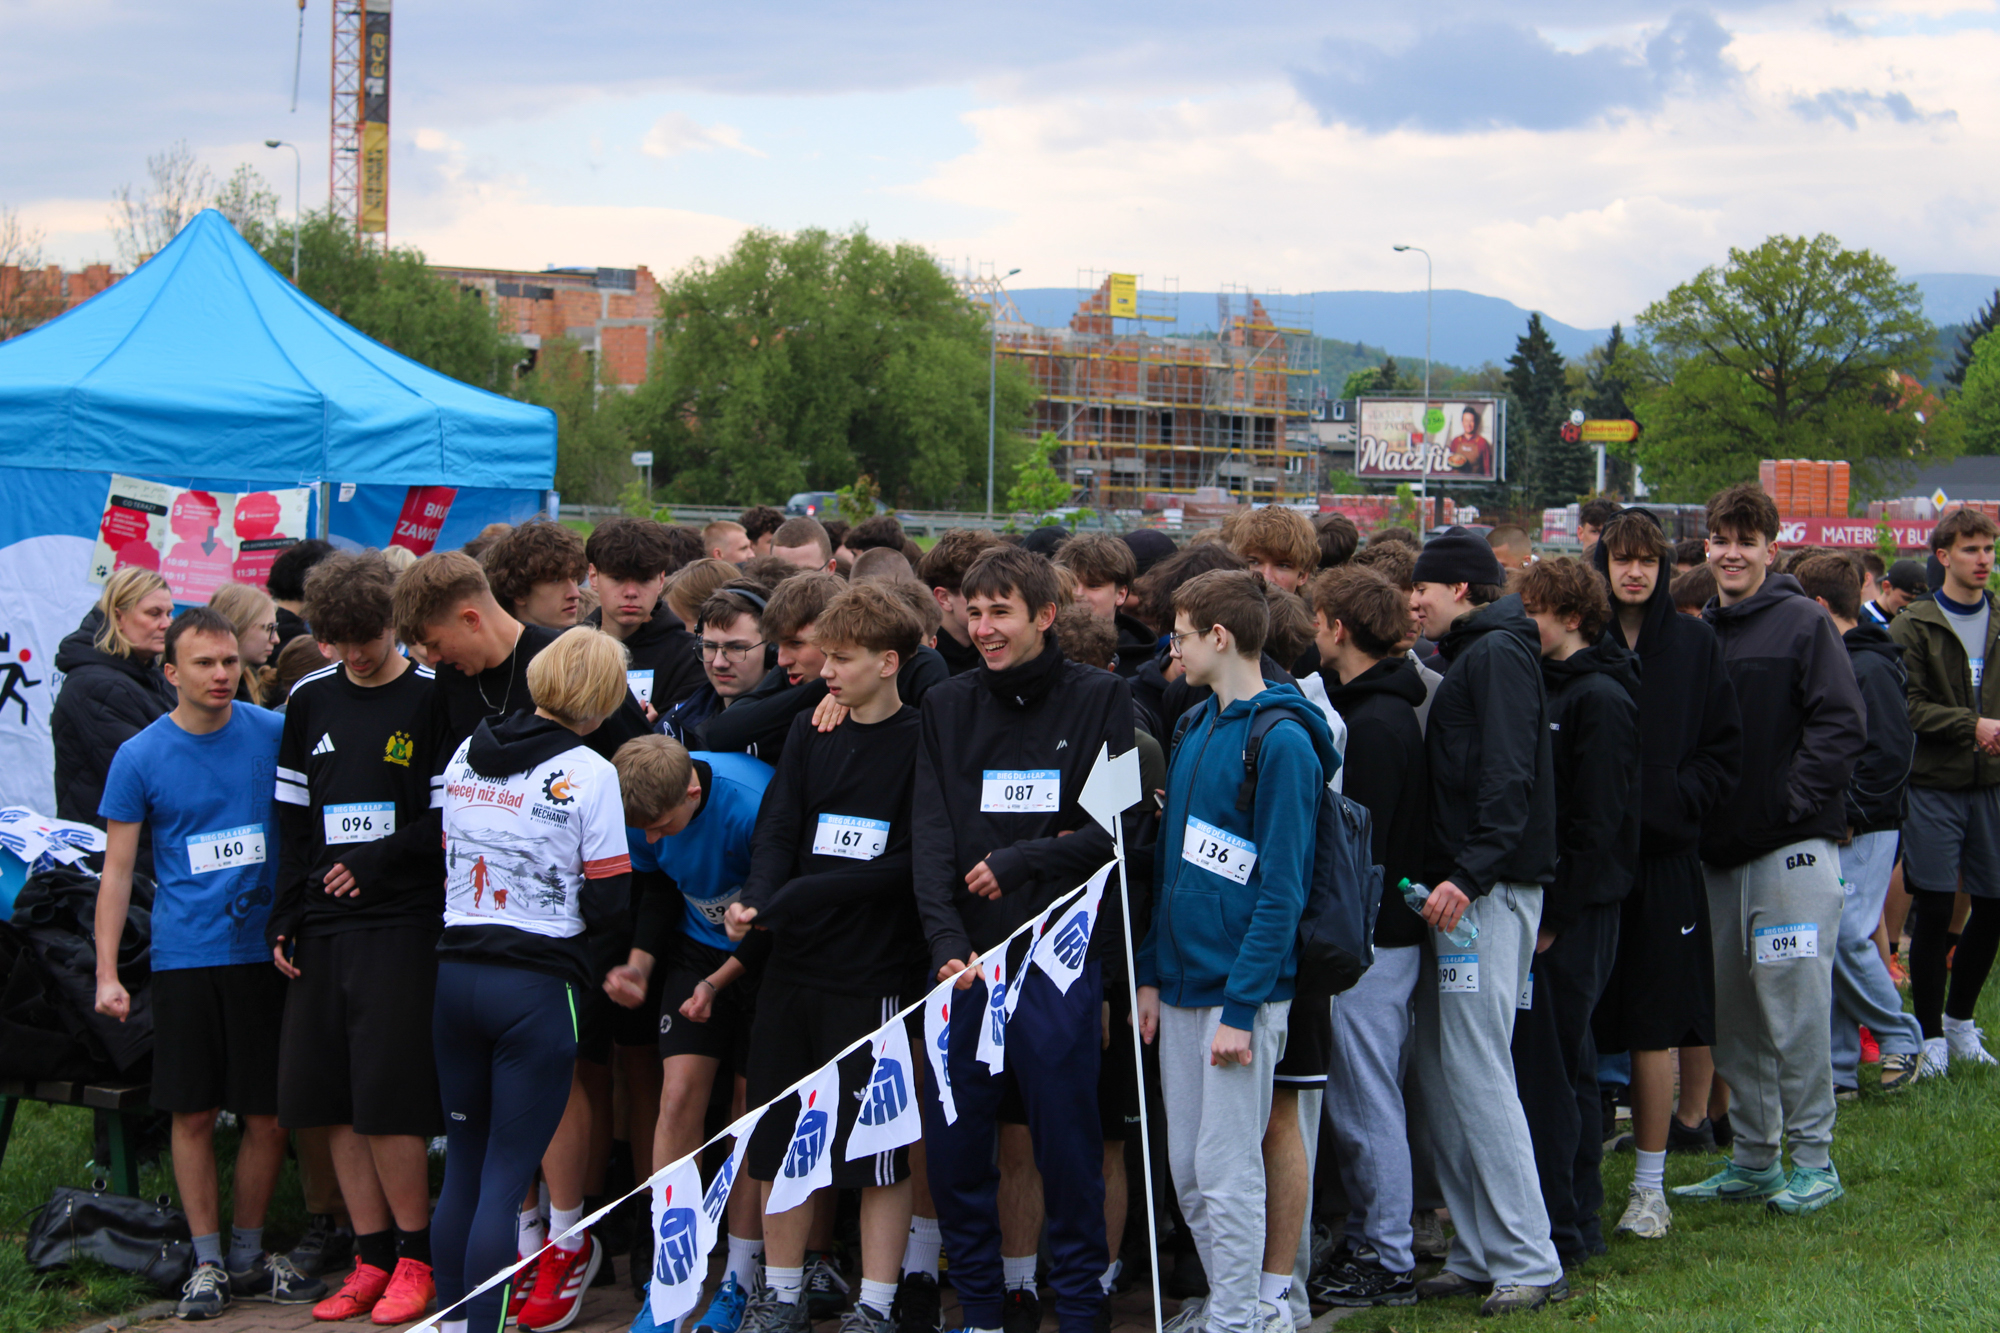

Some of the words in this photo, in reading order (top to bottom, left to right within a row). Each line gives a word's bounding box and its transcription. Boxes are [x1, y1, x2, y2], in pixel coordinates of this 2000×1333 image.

[1360, 435, 1453, 474] Maczfit
[174, 504, 182, 516] 3
[237, 510, 245, 521] 4
[424, 502, 449, 519] BIU
[104, 515, 111, 527] 1
[397, 520, 440, 541] ZAWO
[167, 557, 189, 567] 10:00
[1013, 772, 1027, 780] DLA
[447, 780, 477, 803] więcej
[477, 786, 495, 802] niż
[497, 788, 525, 809] ślad
[1004, 784, 1034, 801] 087
[342, 816, 372, 832] 096
[531, 807, 570, 825] MECHANIK
[828, 816, 843, 825] BIEG
[843, 818, 856, 826] DLA
[200, 834, 217, 843] BIEG
[218, 831, 232, 839] DLA
[834, 830, 863, 847] 167
[1196, 822, 1211, 834] BIEG
[1211, 829, 1226, 840] DLA
[214, 841, 243, 859] 160
[1198, 839, 1230, 863] 136
[1786, 853, 1816, 870] GAP
[699, 906, 726, 918] 159
[1772, 936, 1797, 951] 094
